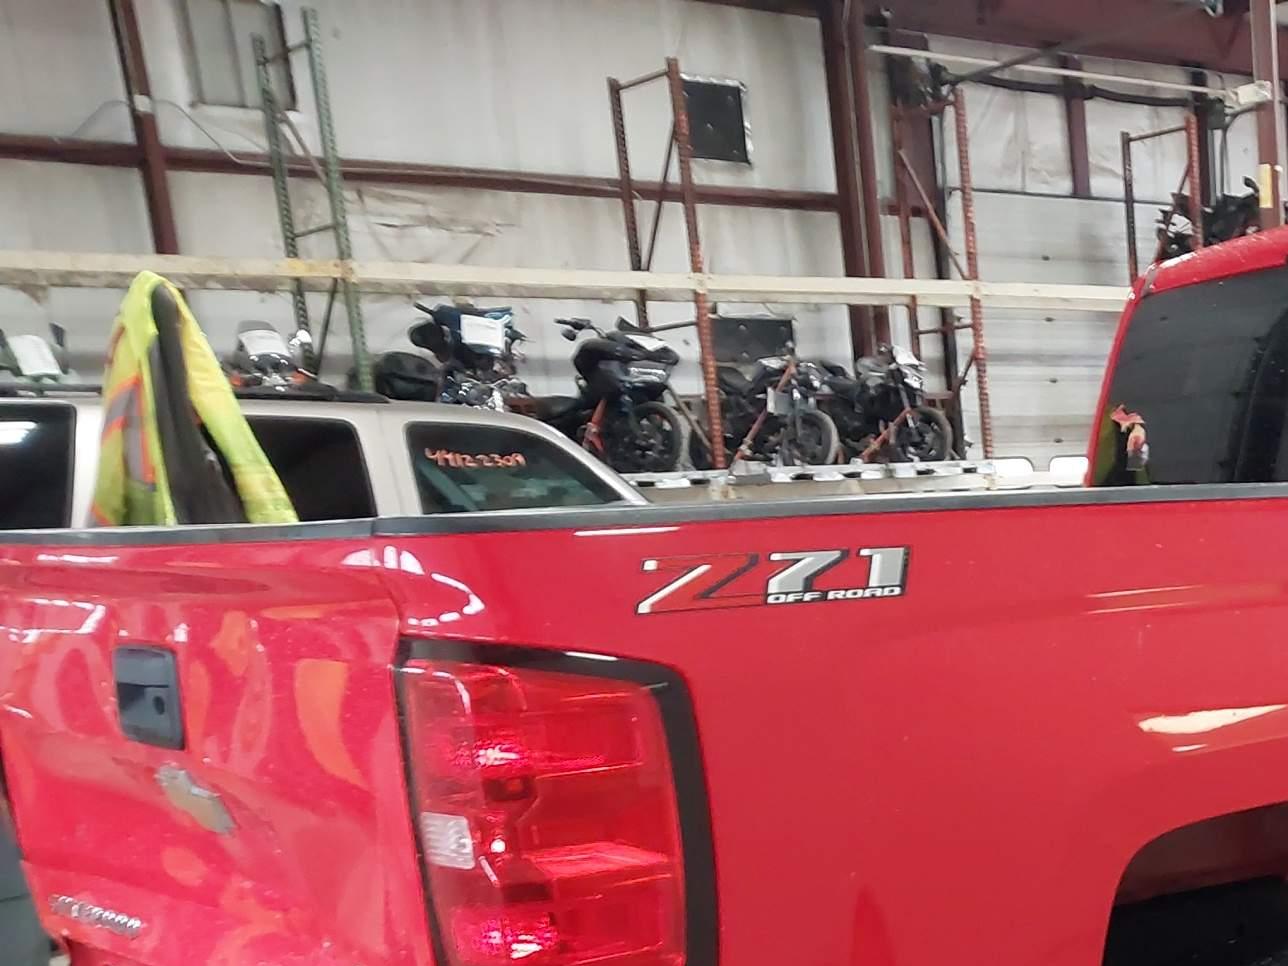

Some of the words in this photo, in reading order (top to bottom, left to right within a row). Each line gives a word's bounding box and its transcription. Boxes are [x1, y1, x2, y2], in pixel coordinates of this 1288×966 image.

[634, 546, 911, 615] Z71
[766, 591, 823, 606] OFF
[826, 585, 903, 600] ROAD
